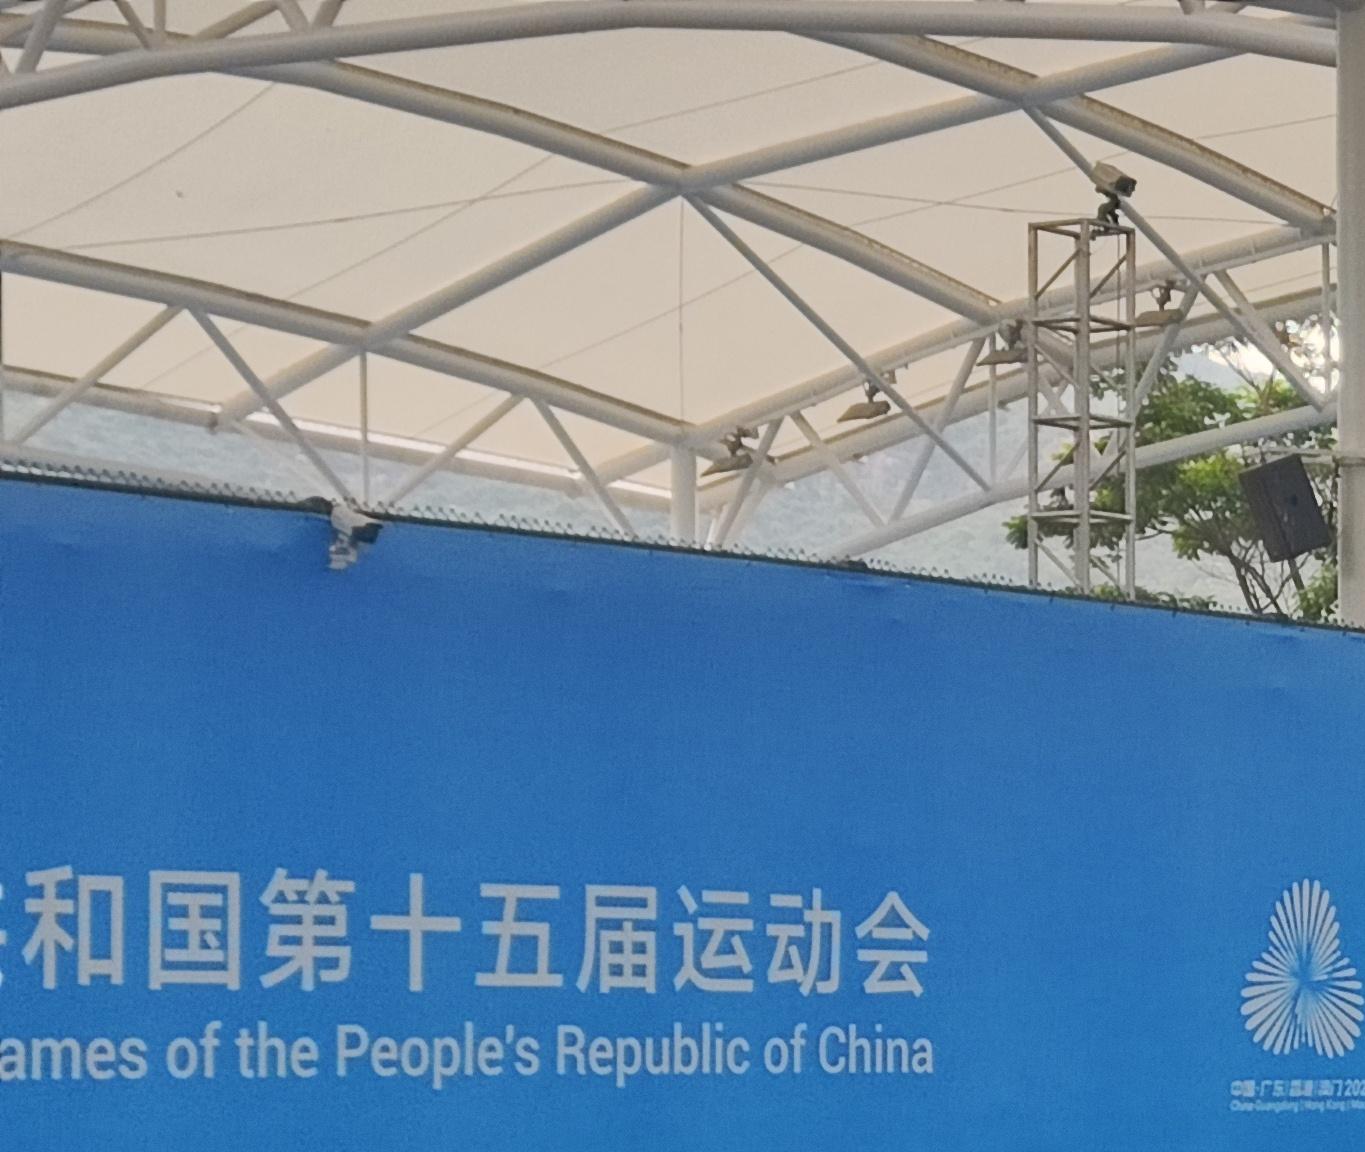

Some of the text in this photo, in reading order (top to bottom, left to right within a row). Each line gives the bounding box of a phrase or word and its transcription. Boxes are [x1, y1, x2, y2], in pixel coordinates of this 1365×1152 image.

[0, 865, 931, 998] 和国第十五届运动会
[166, 1020, 222, 1079] of
[235, 1020, 319, 1079] the
[336, 1021, 541, 1090] People's
[556, 1021, 751, 1088] Republic
[764, 1022, 808, 1075] of
[819, 1023, 934, 1075] China
